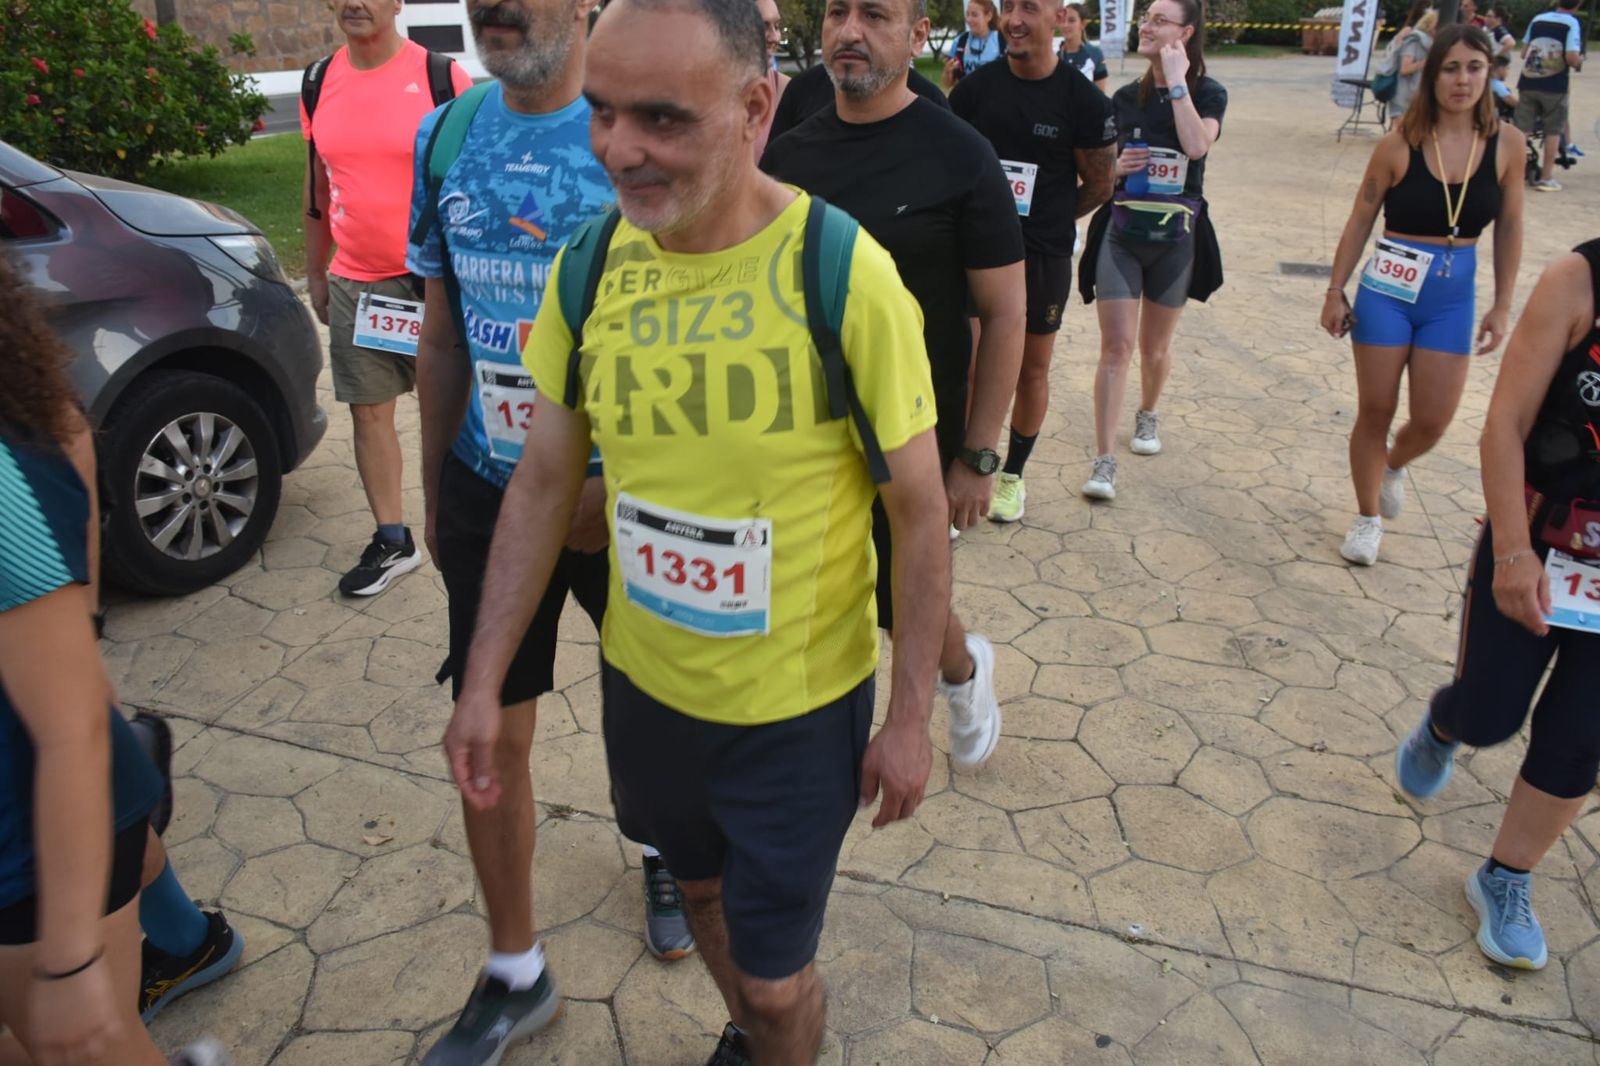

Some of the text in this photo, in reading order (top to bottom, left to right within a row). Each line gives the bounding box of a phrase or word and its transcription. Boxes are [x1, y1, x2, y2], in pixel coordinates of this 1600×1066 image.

[454, 254, 525, 287] CARRERA
[369, 314, 420, 336] 1378
[637, 542, 746, 596] 1331
